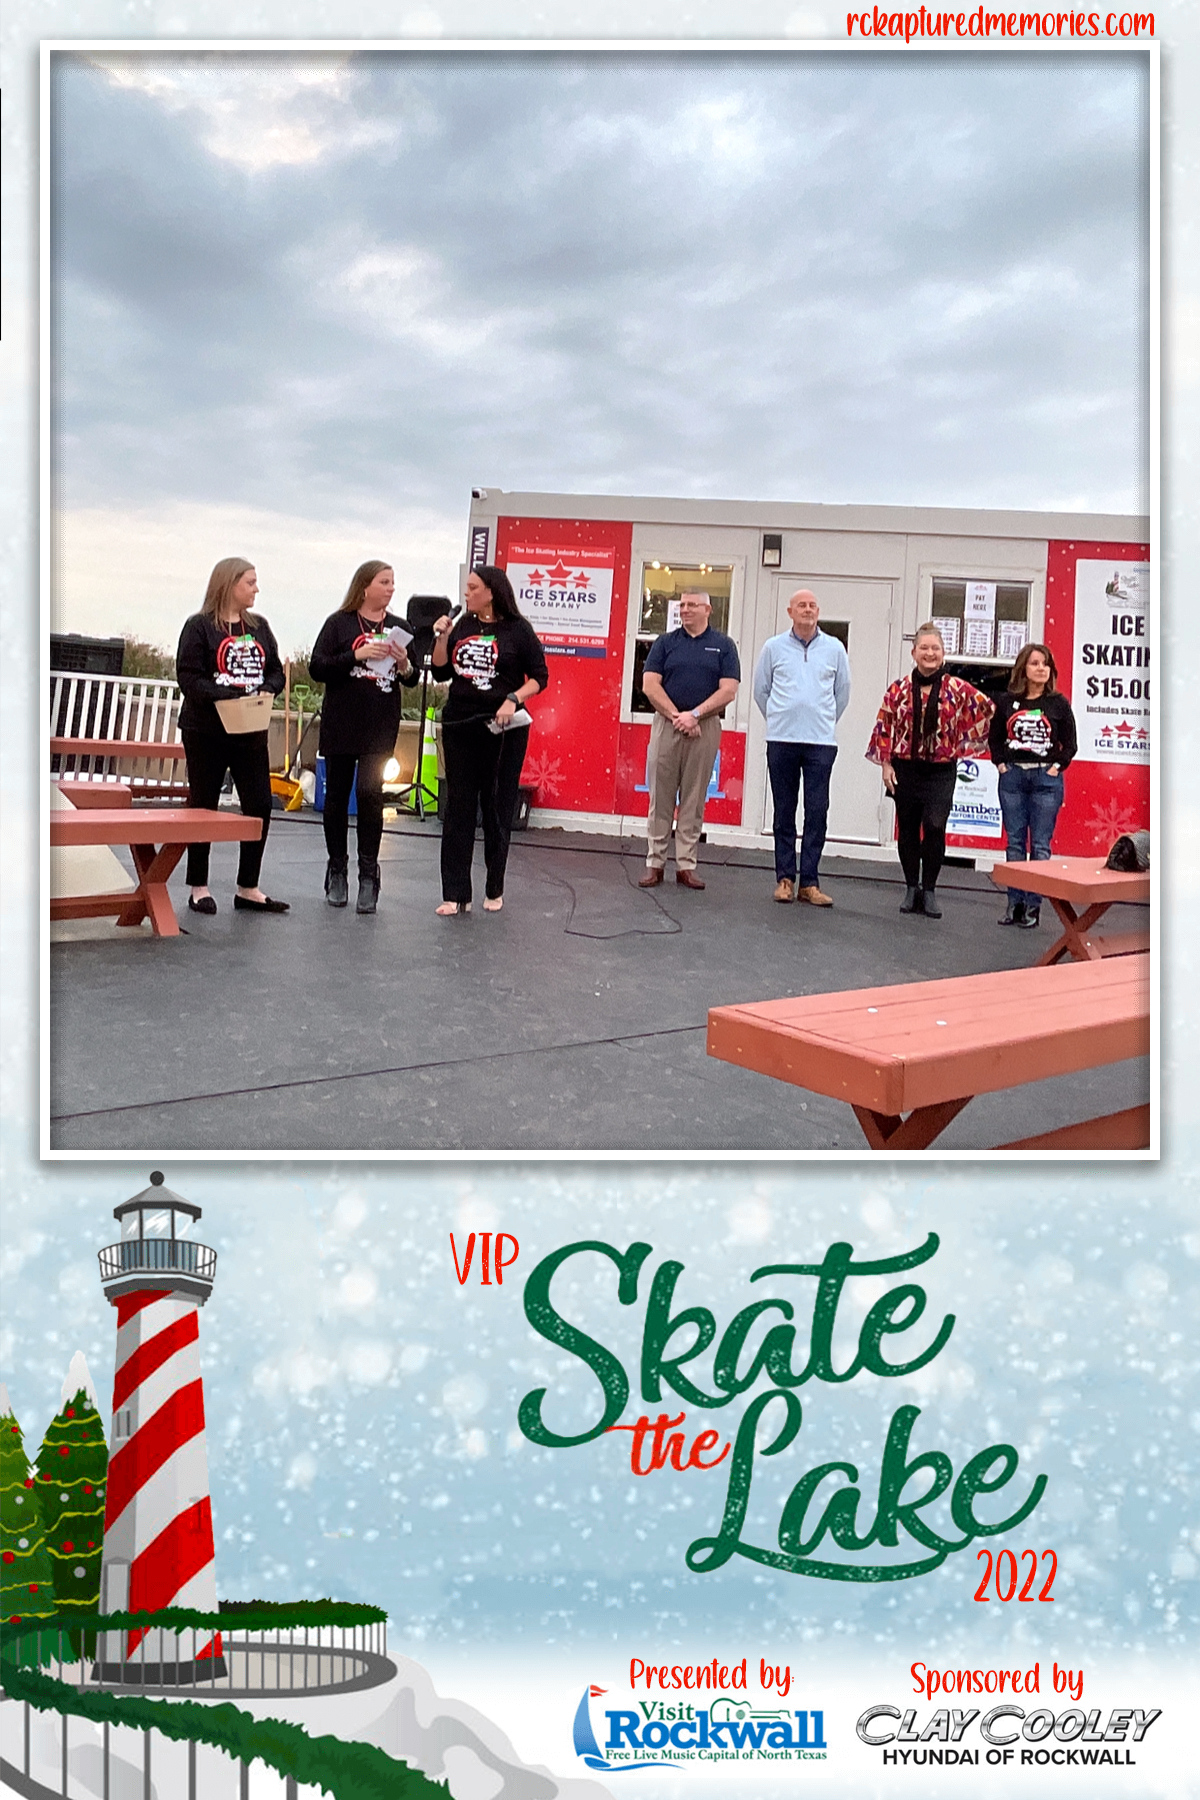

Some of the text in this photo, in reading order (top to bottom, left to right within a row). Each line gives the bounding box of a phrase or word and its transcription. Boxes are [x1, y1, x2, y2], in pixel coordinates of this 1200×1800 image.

[519, 588, 597, 603] ICE STARS
[533, 601, 581, 609] COMPANY
[972, 603, 987, 612] HERE
[1112, 614, 1145, 636] ICE
[1086, 705, 1119, 715] Includes
[1121, 707, 1142, 716] Skate
[1094, 738, 1150, 750] ICE STAR
[953, 803, 1001, 815] hamber
